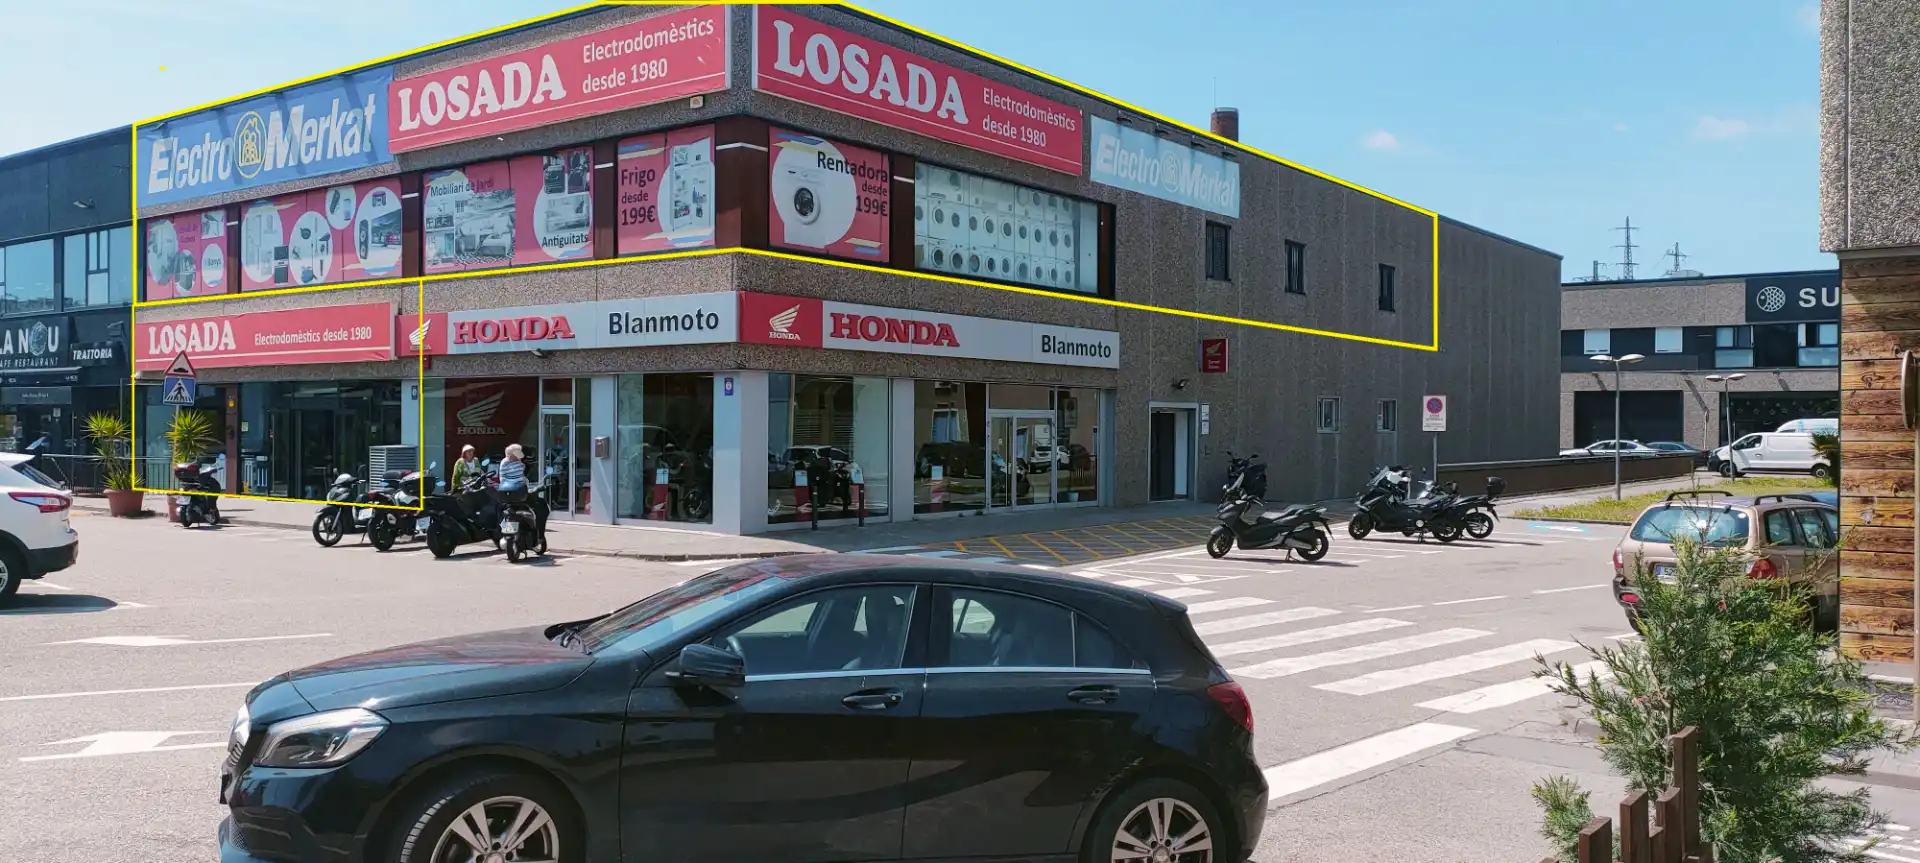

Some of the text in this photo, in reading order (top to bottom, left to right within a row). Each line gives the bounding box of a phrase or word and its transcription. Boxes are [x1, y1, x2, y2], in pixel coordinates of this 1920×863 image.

[583, 17, 715, 64] Electrodomèstics
[582, 57, 668, 95] desde 1980
[774, 19, 969, 125] LOSADA
[398, 54, 567, 132] LOSADA
[982, 87, 1076, 132] Electrodomèstics
[148, 93, 376, 194] Electro Merkat
[982, 114, 1047, 148] desde 1980
[621, 166, 656, 188] Frigo
[816, 150, 889, 183] Rentadora
[1096, 133, 1237, 208] Electro Merkat
[431, 179, 464, 198] Mobiliari
[621, 190, 649, 205] desde
[861, 180, 888, 198] desde
[621, 205, 656, 226] 199€
[856, 195, 889, 217] 199€
[542, 232, 589, 249] Antiguitats
[453, 314, 576, 345] HONDA
[608, 306, 719, 336] Blanmoto
[768, 331, 802, 341] HONDA
[829, 312, 961, 348] HONDA
[149, 319, 237, 356] LOSADA
[254, 326, 372, 347] Electrodomèstics desde 1980
[1041, 333, 1112, 360] Blanmoto
[73, 348, 112, 360] TRATTORIA
[456, 426, 507, 435] HONDA
